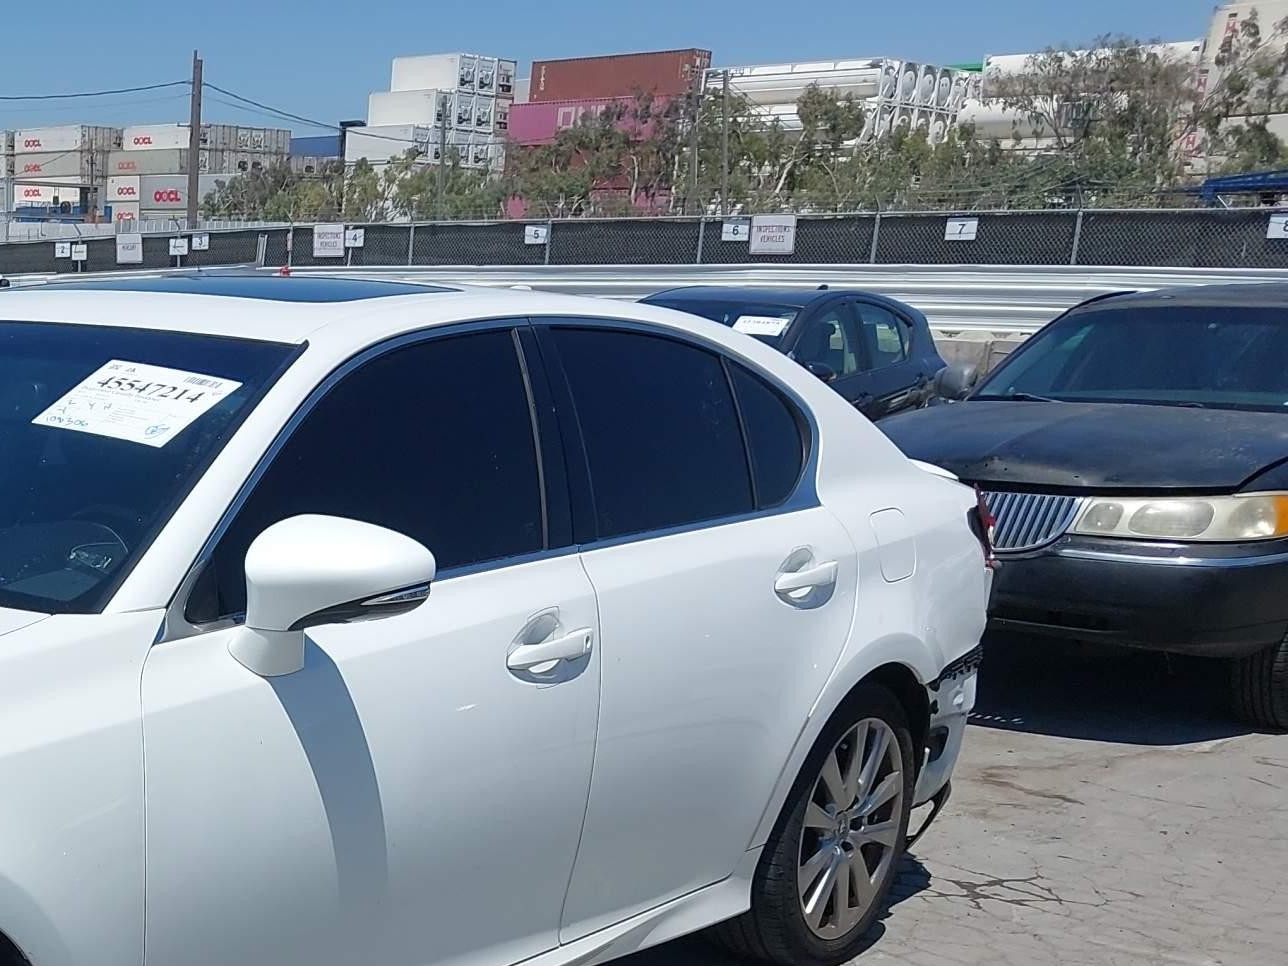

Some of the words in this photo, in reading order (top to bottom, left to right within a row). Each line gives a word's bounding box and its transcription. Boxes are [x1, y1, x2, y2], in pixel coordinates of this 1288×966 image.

[24, 139, 41, 148] OOCL
[133, 136, 152, 145] OOCL
[23, 188, 42, 197] OOCL
[117, 186, 136, 196] OOCL
[154, 190, 180, 203] OOCL
[732, 225, 739, 235] 6
[958, 223, 966, 234] 7
[352, 232, 358, 242] 4
[533, 229, 540, 239] 5
[60, 245, 65, 254] 2
[97, 375, 206, 403] 45547214
